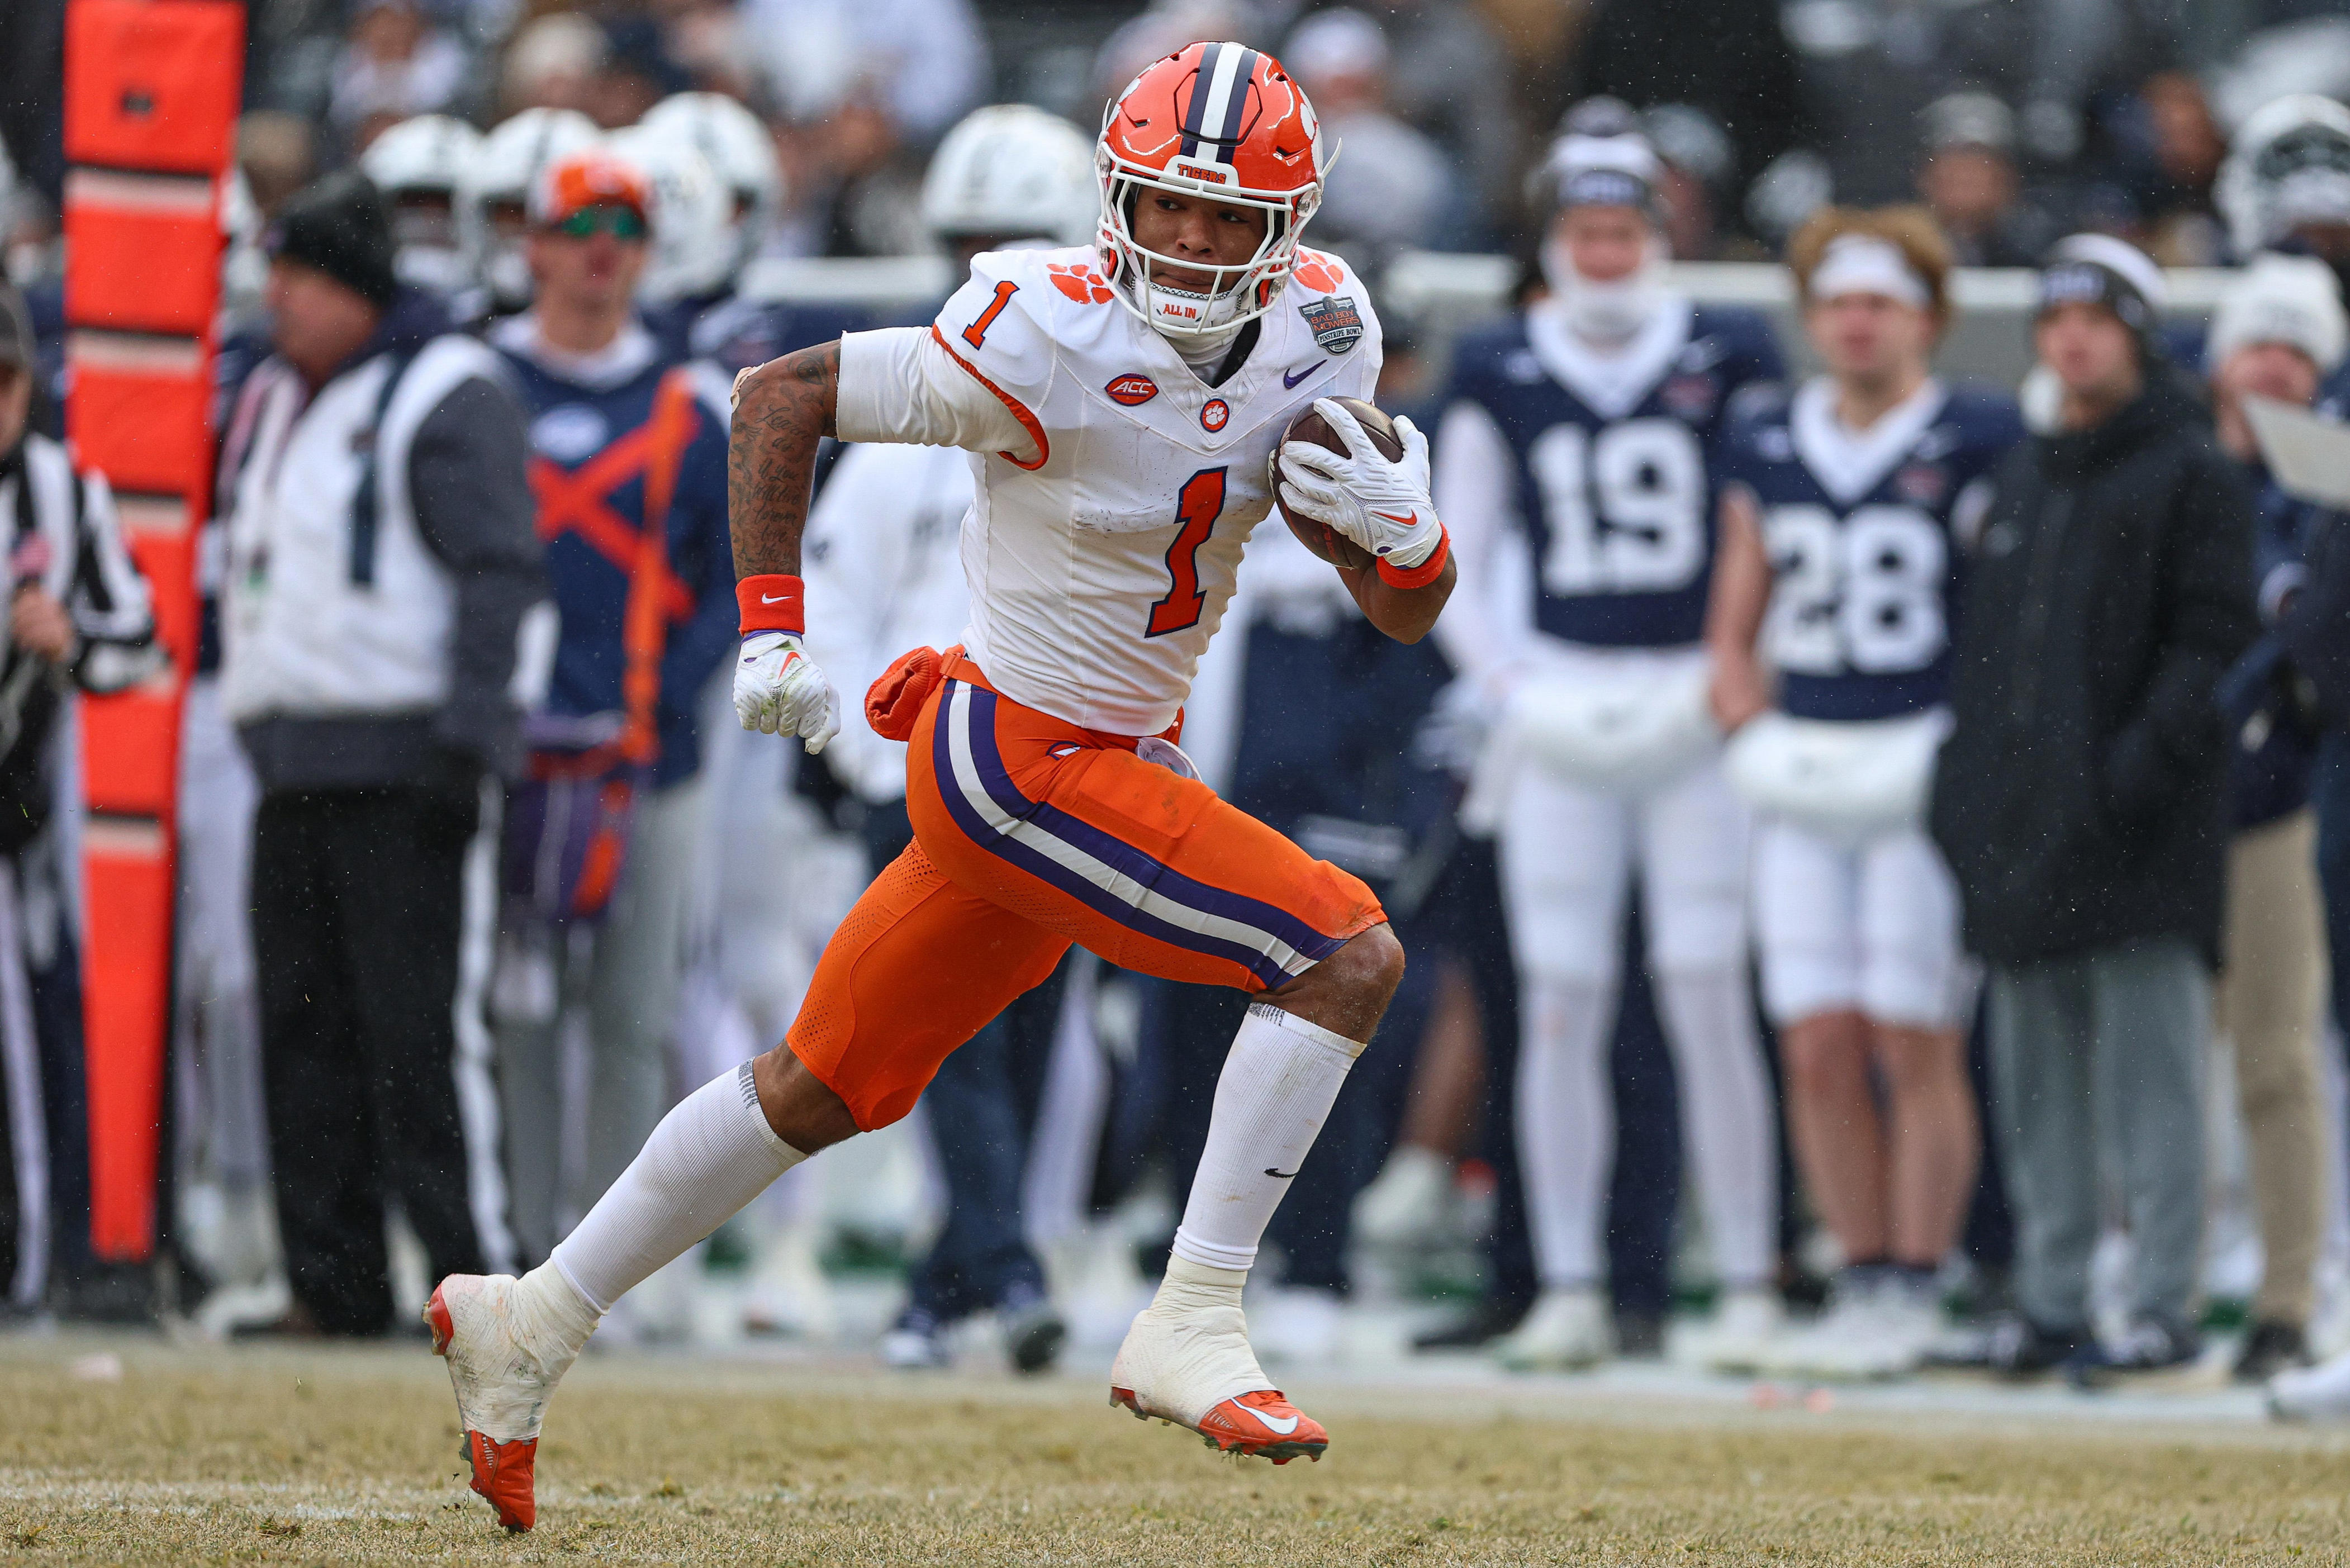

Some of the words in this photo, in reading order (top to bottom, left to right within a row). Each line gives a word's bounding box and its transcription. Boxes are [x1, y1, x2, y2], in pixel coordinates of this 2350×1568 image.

[1178, 163, 1226, 184] TIGERS
[962, 281, 1020, 351] 1
[1163, 304, 1182, 316] ALL
[1185, 307, 1197, 319] IN
[1311, 313, 1334, 324] BAD
[1335, 310, 1354, 319] BOY
[1313, 316, 1360, 331] MOWERS
[1319, 330, 1345, 343] PINSTRIPE
[1112, 381, 1152, 394] ACC
[1530, 417, 1707, 595] 19
[1144, 465, 1228, 638] 1
[1759, 503, 1949, 675] 28
